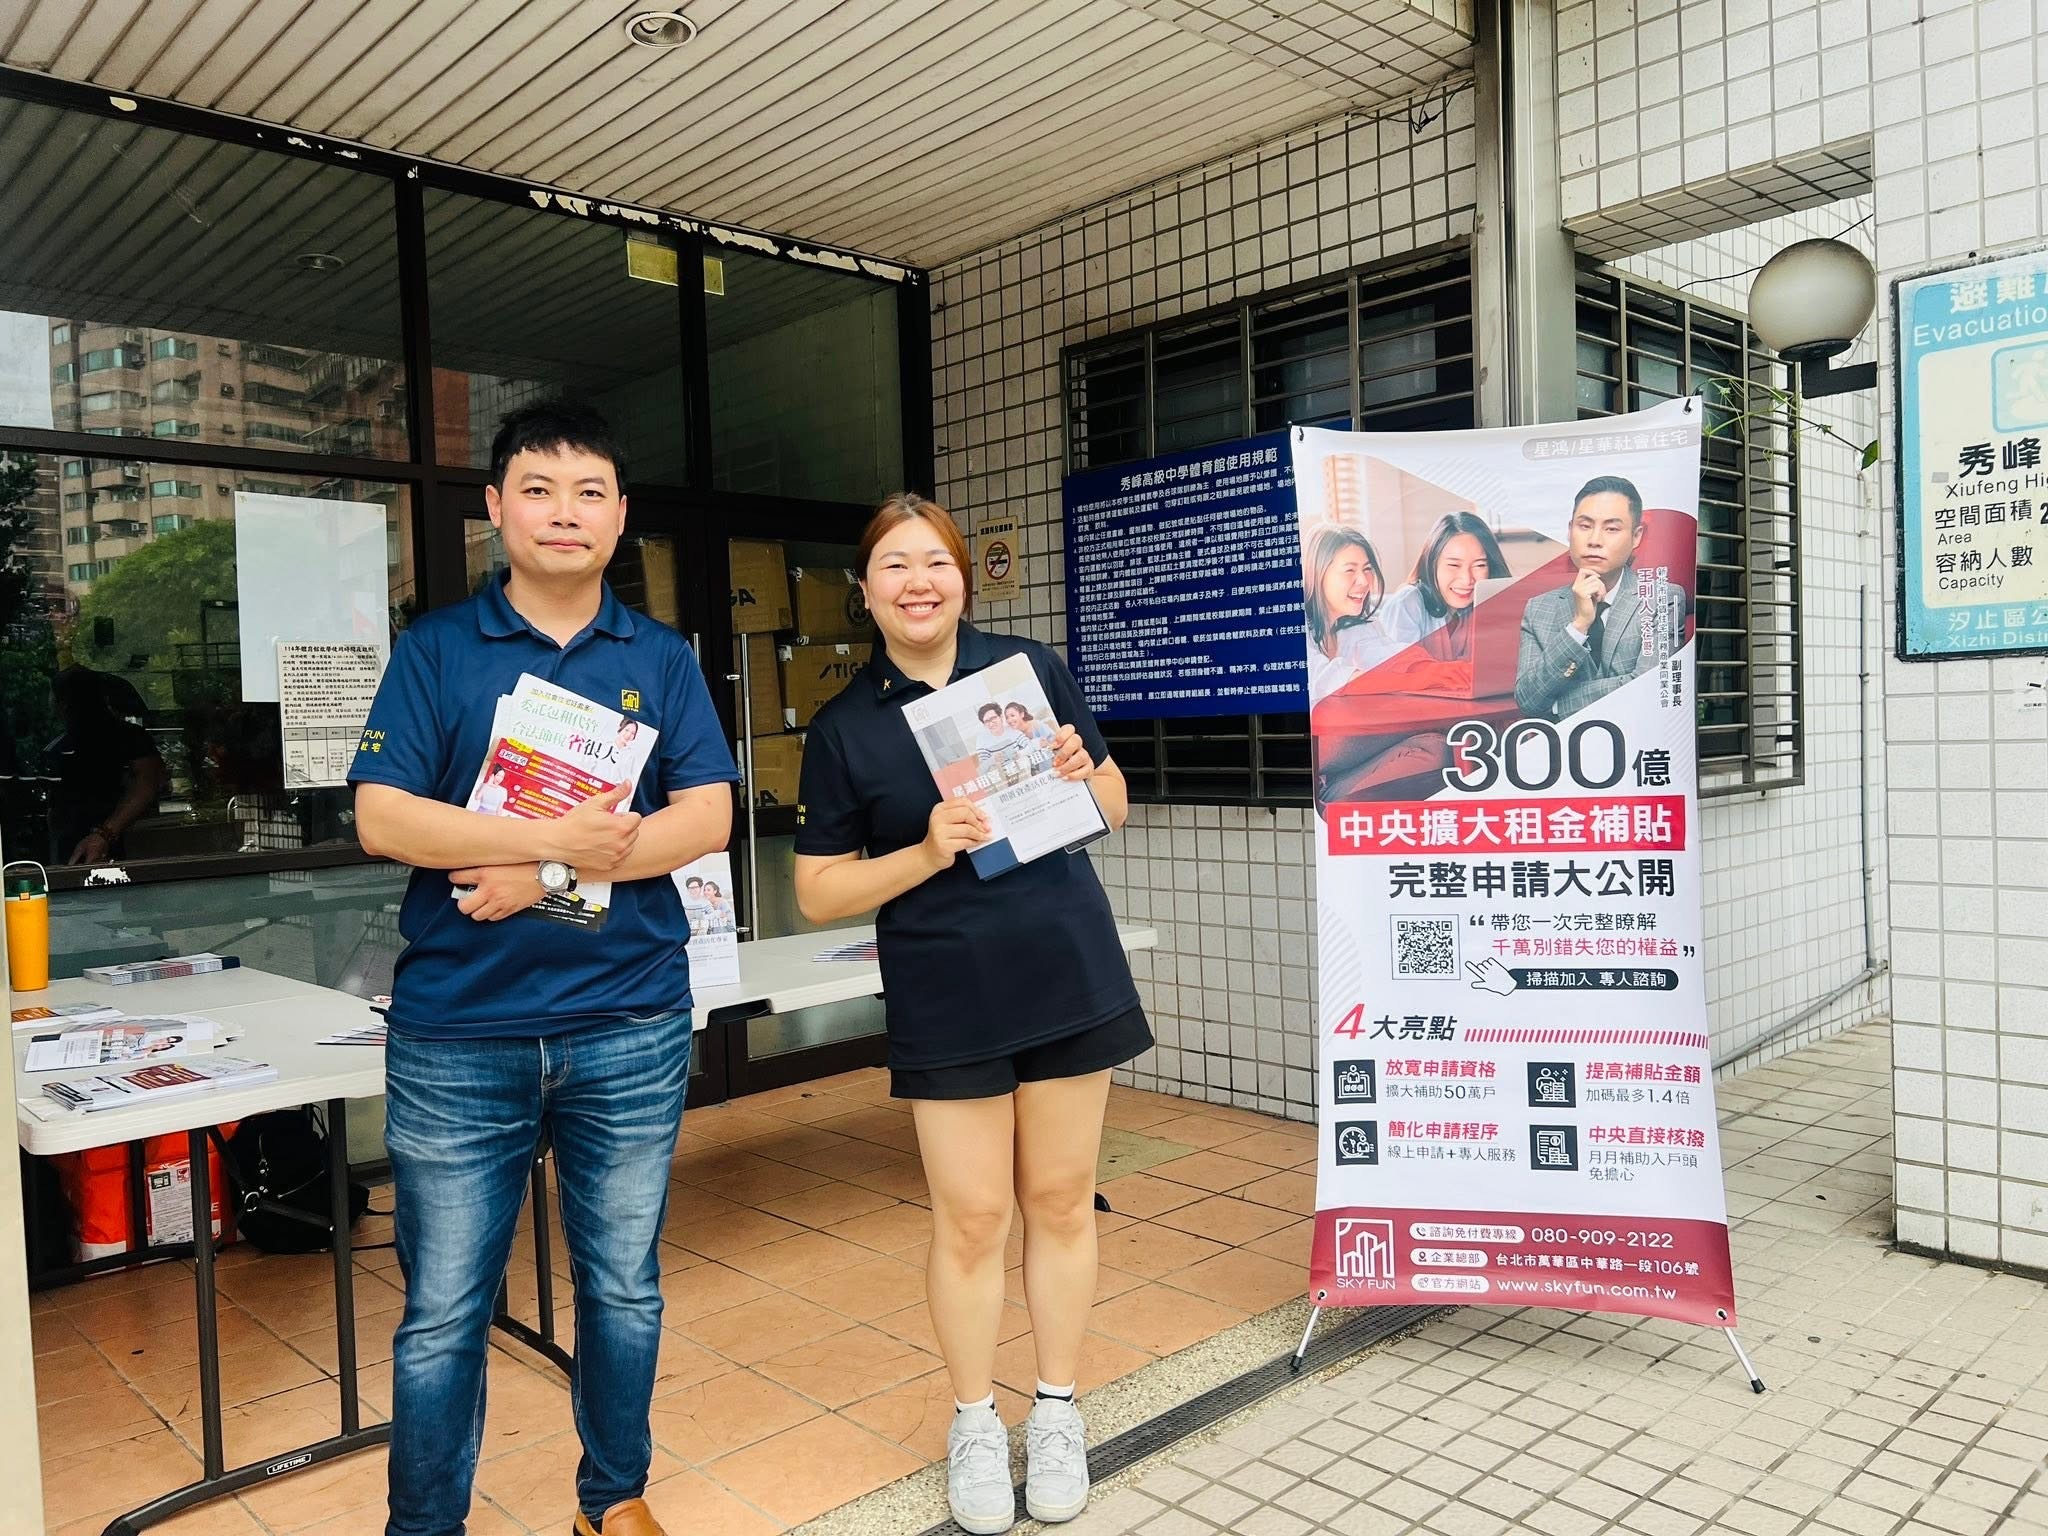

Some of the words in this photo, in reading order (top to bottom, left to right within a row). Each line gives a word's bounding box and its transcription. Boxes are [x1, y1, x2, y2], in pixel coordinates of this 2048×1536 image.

[1950, 272, 2048, 313] 避難
[1914, 305, 2047, 346] Evacuatio
[1958, 437, 2041, 478] 秀峰
[1946, 478, 2018, 498] Xiufeng
[2025, 472, 2048, 490] Hi
[1935, 499, 2032, 530] 空間面積
[1938, 532, 1972, 545] Area
[1936, 545, 2033, 574] 容納人數
[1939, 573, 2004, 590] Capacity
[1948, 633, 1996, 648] Xizhi
[1671, 660, 1682, 707] 副理事長
[1338, 803, 1672, 848] 中央擴大租金補貼
[1389, 858, 1675, 899] 完整申請大公開
[1526, 972, 1593, 987] 掃描加入
[1599, 972, 1667, 987] 專人諮詢
[1333, 1003, 1457, 1041] 4大亮點
[1385, 1059, 1497, 1078] 放寬申請資格
[1586, 1062, 1702, 1085] 提高補貼金額
[1386, 1084, 1497, 1101] 擴大補助50萬戶
[1586, 1087, 1691, 1106] 加碼最多1.4倍
[1388, 1120, 1499, 1141] 簡化申請程序
[1588, 1126, 1706, 1149] 中央直接核撥
[1588, 1151, 1699, 1169] 月月補助入戶頭
[1589, 1167, 1635, 1183] 免擔心
[1430, 1226, 1518, 1241] 諮詢免付費專線
[1531, 1226, 1674, 1249] 080-909-2122
[1431, 1252, 1481, 1265] 企業總部
[1495, 1253, 1700, 1277] 台北市萬華區中華路一段106號
[1336, 1278, 1363, 1289] SKY
[1367, 1279, 1396, 1290] FUN
[1431, 1278, 1482, 1291] 官方網站
[1497, 1278, 1678, 1301] www.skyfun.com.tw
